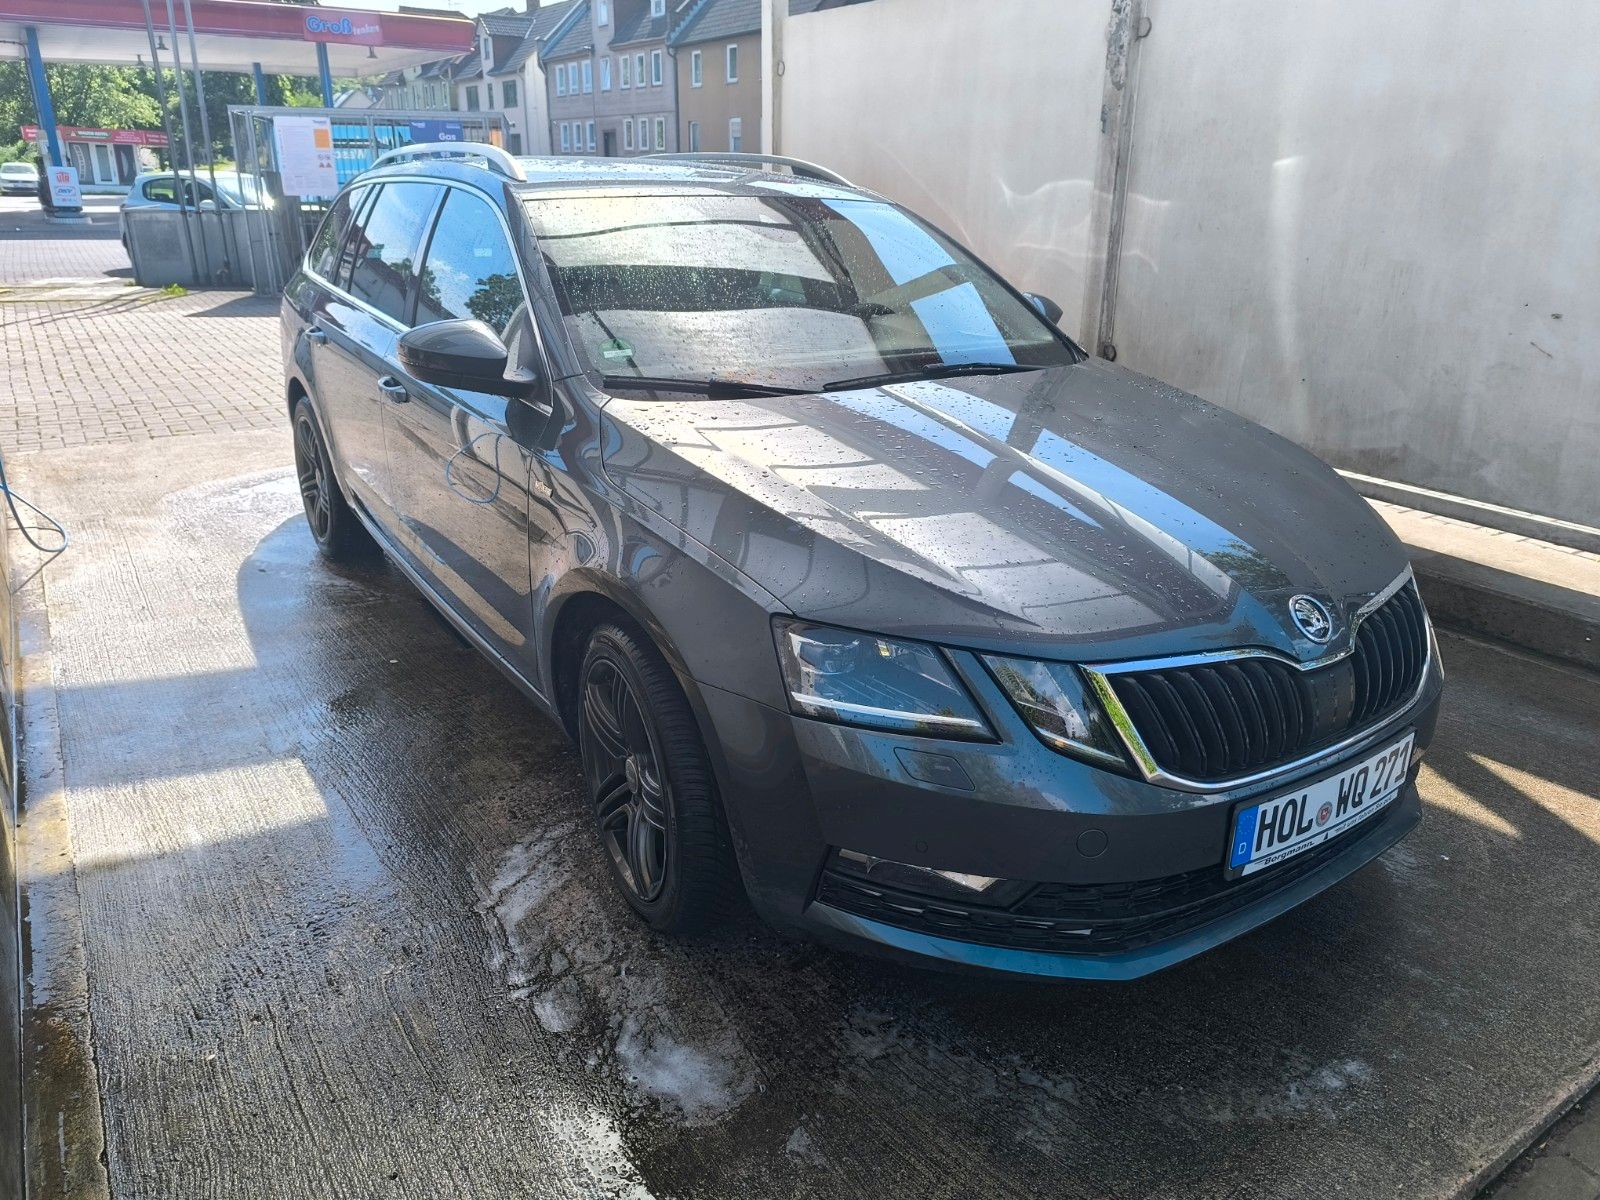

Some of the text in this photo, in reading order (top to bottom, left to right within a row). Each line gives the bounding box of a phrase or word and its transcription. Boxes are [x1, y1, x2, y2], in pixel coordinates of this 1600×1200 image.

[306, 15, 352, 35] Groß
[438, 132, 456, 141] Gas
[1255, 741, 1411, 852] HOL WQ 271
[1238, 842, 1247, 855] D
[1264, 841, 1315, 865] Borgmann
